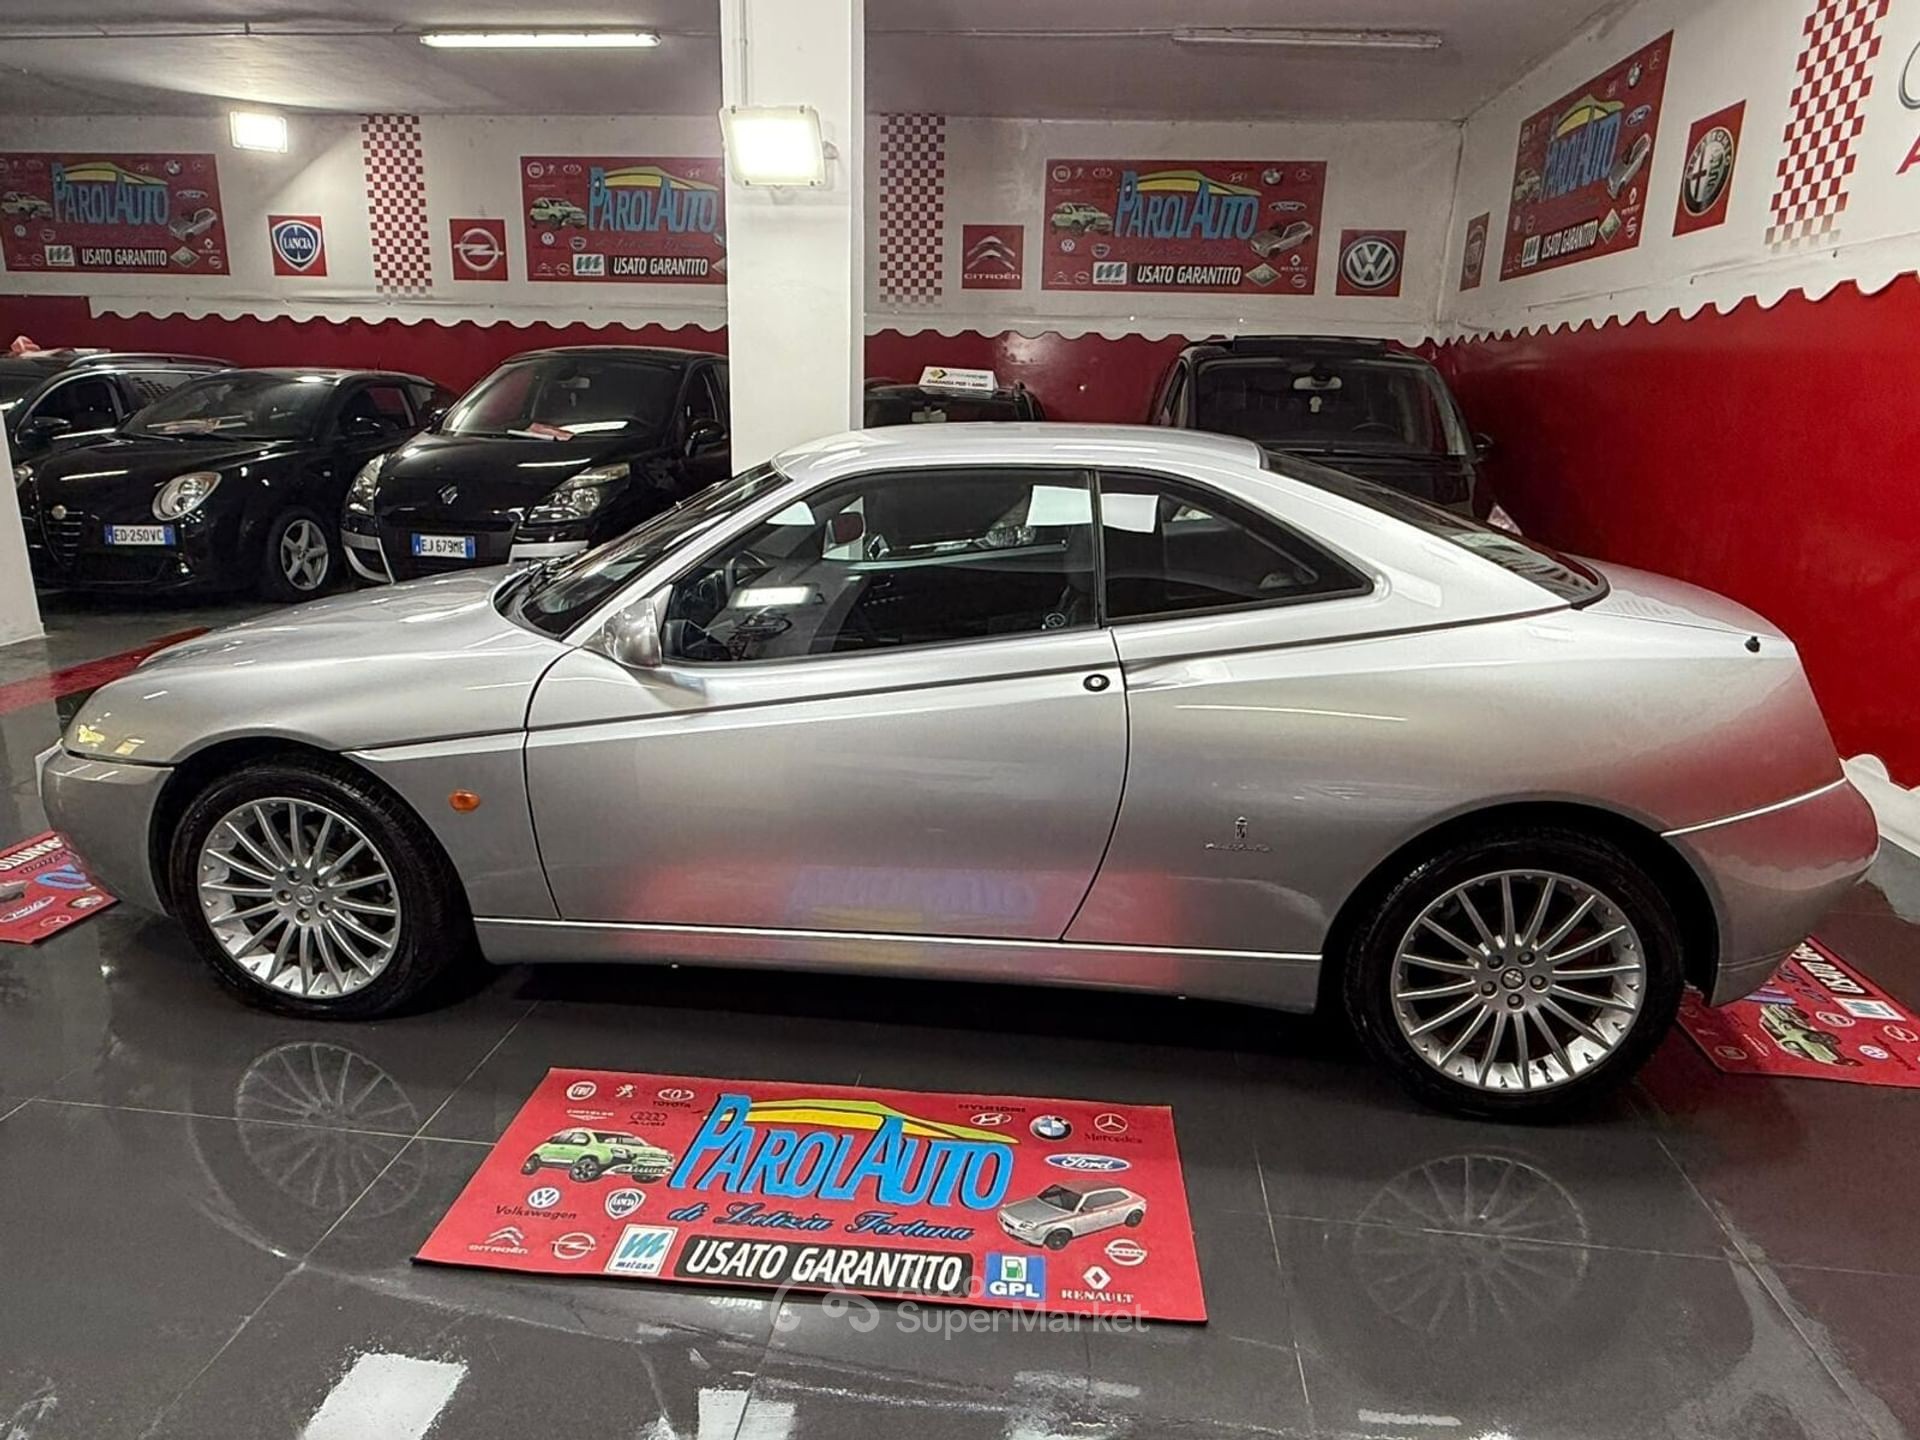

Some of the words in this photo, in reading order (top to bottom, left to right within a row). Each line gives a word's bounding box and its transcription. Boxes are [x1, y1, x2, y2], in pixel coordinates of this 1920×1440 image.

[587, 166, 718, 233] PAROLAUTO
[1114, 169, 1259, 240] PAROLAUTO
[283, 237, 313, 250] LANCIA
[82, 248, 112, 265] USATO
[114, 248, 167, 266] GARANTITO
[613, 257, 647, 275] USATO
[649, 257, 709, 276] GARANTITO
[1137, 265, 1174, 284] USATO
[1176, 266, 1242, 285] GARANTITO
[1084, 1132, 1143, 1144] Mercedes
[667, 1093, 1014, 1212] PAROLAUTO
[1061, 1156, 1114, 1169] Ford
[495, 1205, 577, 1220] Volkswagen
[668, 1202, 708, 1222] di
[685, 1239, 788, 1280] USATO
[791, 1247, 963, 1292] GARANTITO
[989, 1280, 1040, 1298] GPL
[1061, 1288, 1134, 1303] RENAULT
